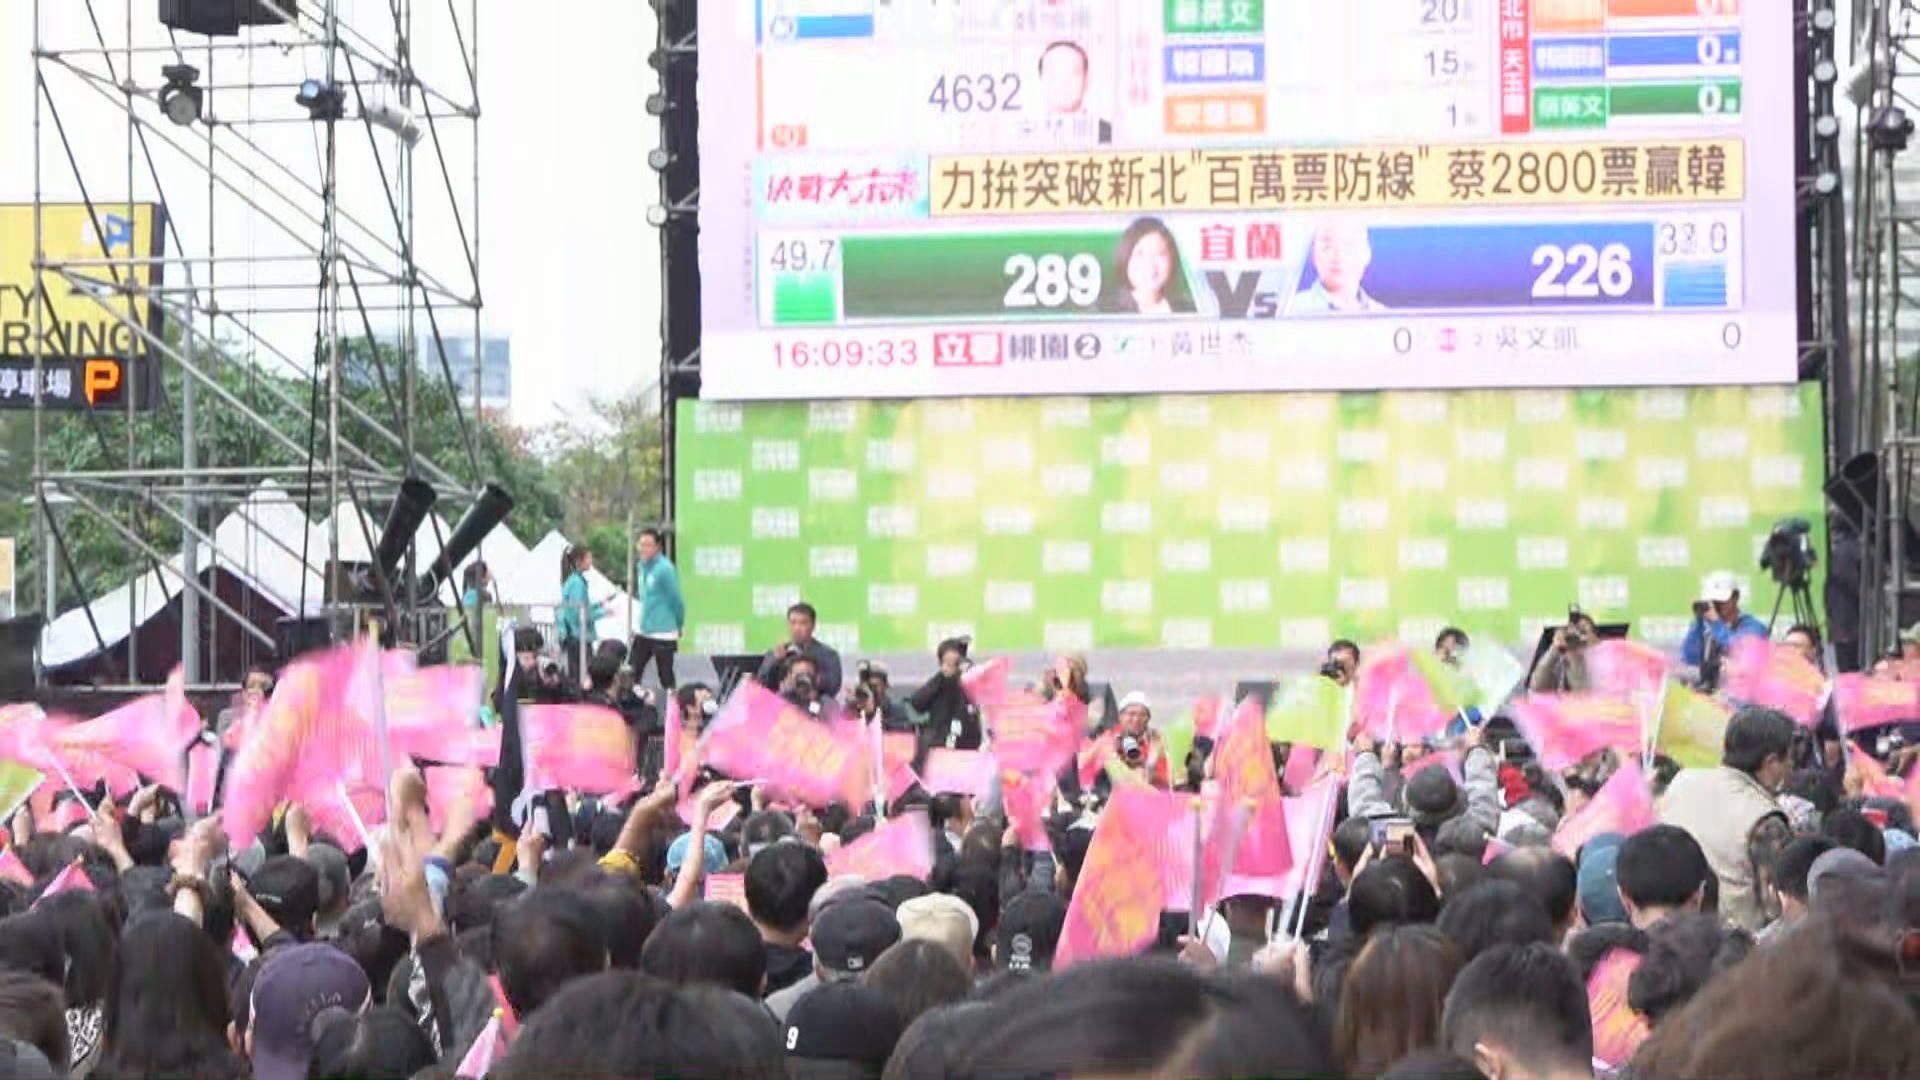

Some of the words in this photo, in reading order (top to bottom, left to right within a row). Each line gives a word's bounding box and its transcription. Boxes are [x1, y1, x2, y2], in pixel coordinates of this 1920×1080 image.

[1424, 48, 1459, 78] 15
[928, 74, 1022, 112] 4632
[1447, 146, 1726, 199] 蔡2800票贏韓
[771, 240, 835, 271] 49.7
[1201, 223, 1282, 260] 宜蘭
[1003, 253, 1101, 307] 289
[1531, 243, 1633, 299] 226
[773, 340, 919, 367] 16:09:33
[85, 359, 120, 408] P
[786, 1026, 799, 1050] 9
